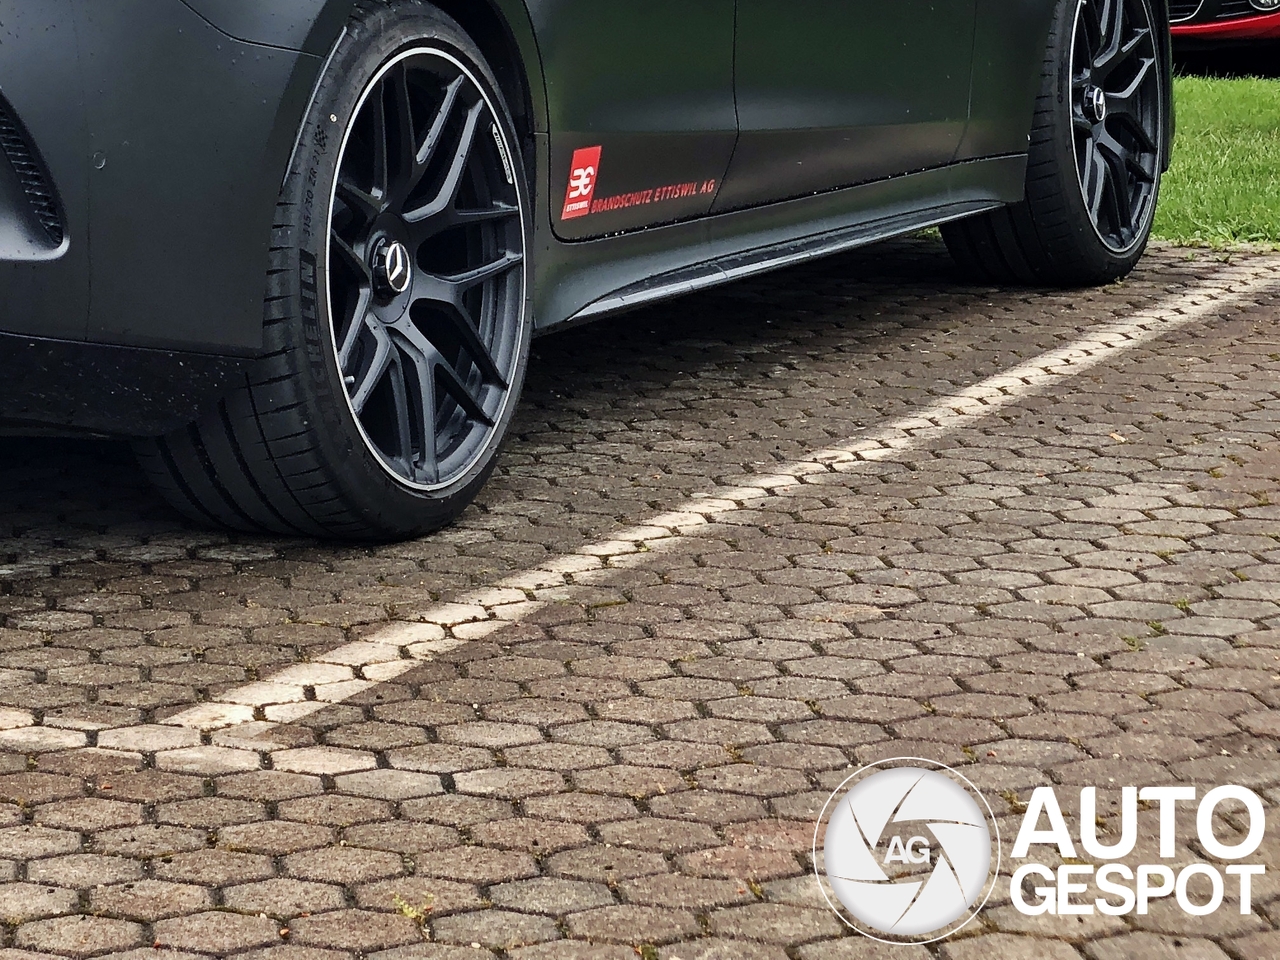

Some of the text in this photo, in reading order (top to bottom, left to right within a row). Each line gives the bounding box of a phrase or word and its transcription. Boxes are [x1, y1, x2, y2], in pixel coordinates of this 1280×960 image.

[591, 179, 715, 214] BRANDSCHUTZ ETTISWIL AG
